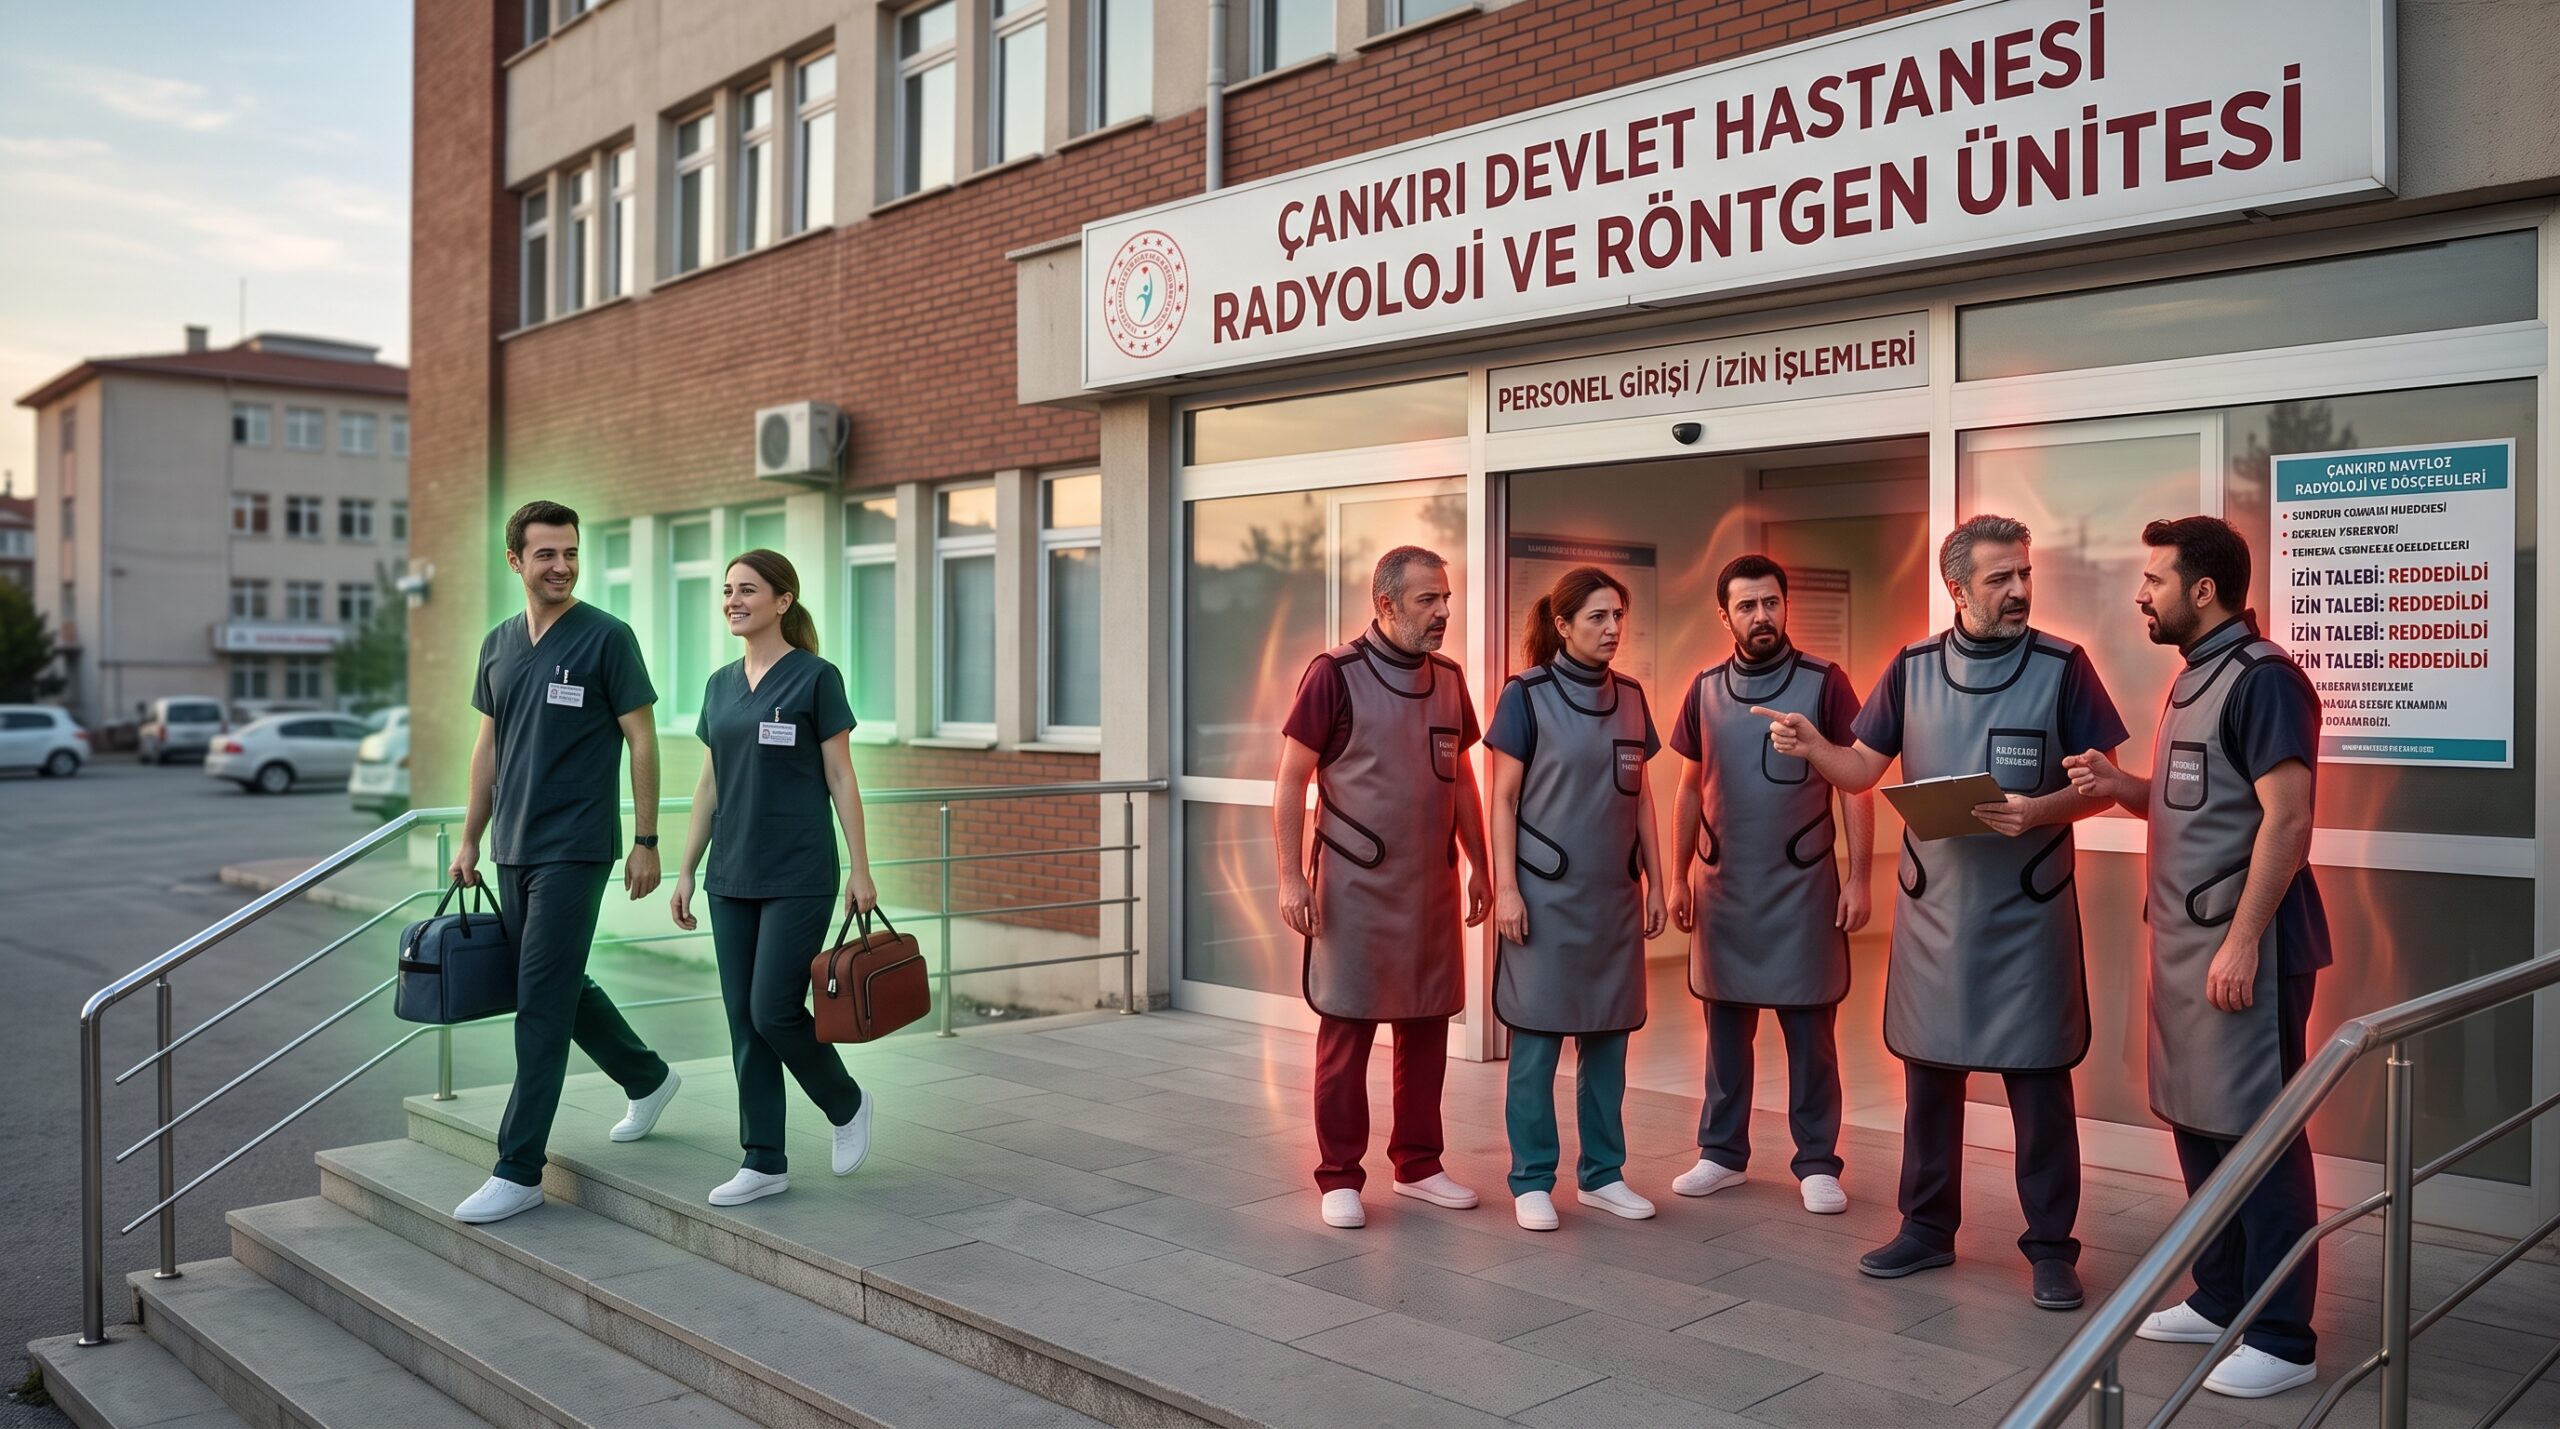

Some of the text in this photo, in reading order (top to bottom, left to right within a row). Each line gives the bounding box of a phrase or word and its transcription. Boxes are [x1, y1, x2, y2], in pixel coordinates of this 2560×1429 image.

[1277, 0, 2106, 262] ÇANKIRI DEVLET HASTANESİ
[1213, 228, 1484, 345] RADYOLOJİ
[1502, 223, 1577, 293] VE
[1598, 155, 1928, 279] RÖNTGEN
[1957, 62, 2302, 215] ÜNİTESİ
[1498, 375, 1614, 412] PERSONEL
[1619, 359, 1689, 398] GİRİŞİ
[1716, 351, 1767, 388] İZİN
[1775, 330, 1916, 386] İŞLEMLERİ
[2295, 477, 2367, 496] RADYOLOJİ
[2370, 478, 2388, 491] VE
[2291, 561, 2489, 587] İZİN TALEBİ: REDDEDİLDİ
[2291, 590, 2489, 615] İZİN TALEBİ: REDDEDİLDİ
[2291, 619, 2489, 642] İZİN TALEBİ: REDDEDİLDİ
[2325, 649, 2385, 669] TALEBİ:
[2388, 648, 2489, 669] REDDEDİLDİ
